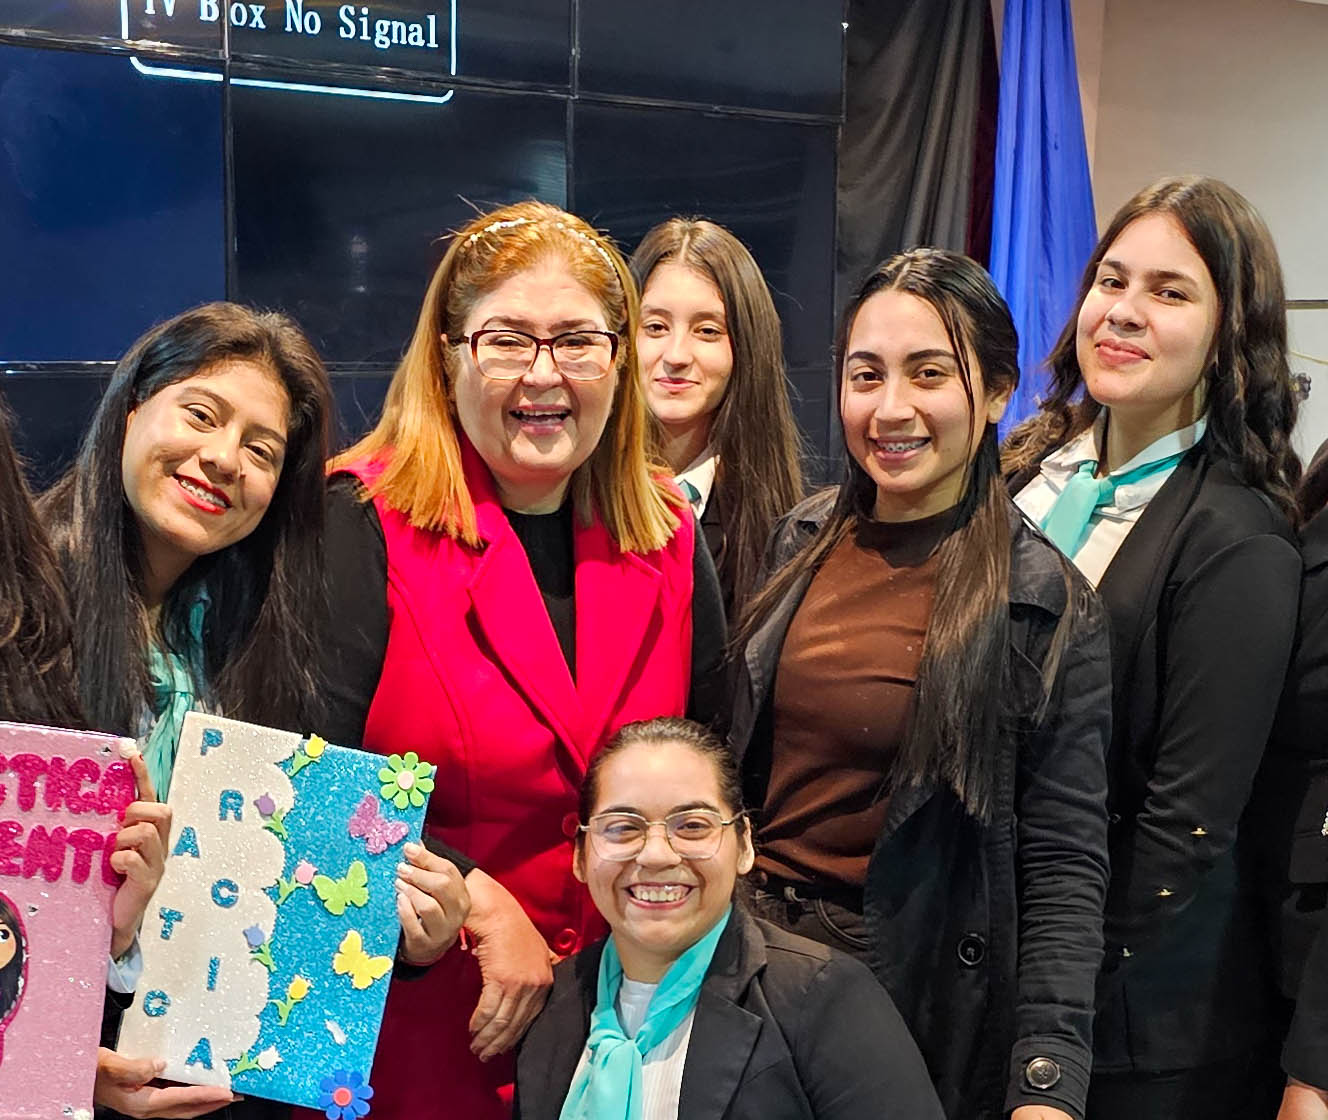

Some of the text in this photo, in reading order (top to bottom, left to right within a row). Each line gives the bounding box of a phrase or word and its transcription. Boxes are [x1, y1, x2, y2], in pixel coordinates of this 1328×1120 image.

[199, 0, 266, 29] Box
[284, 0, 322, 35] No
[339, 4, 439, 48] Signal
